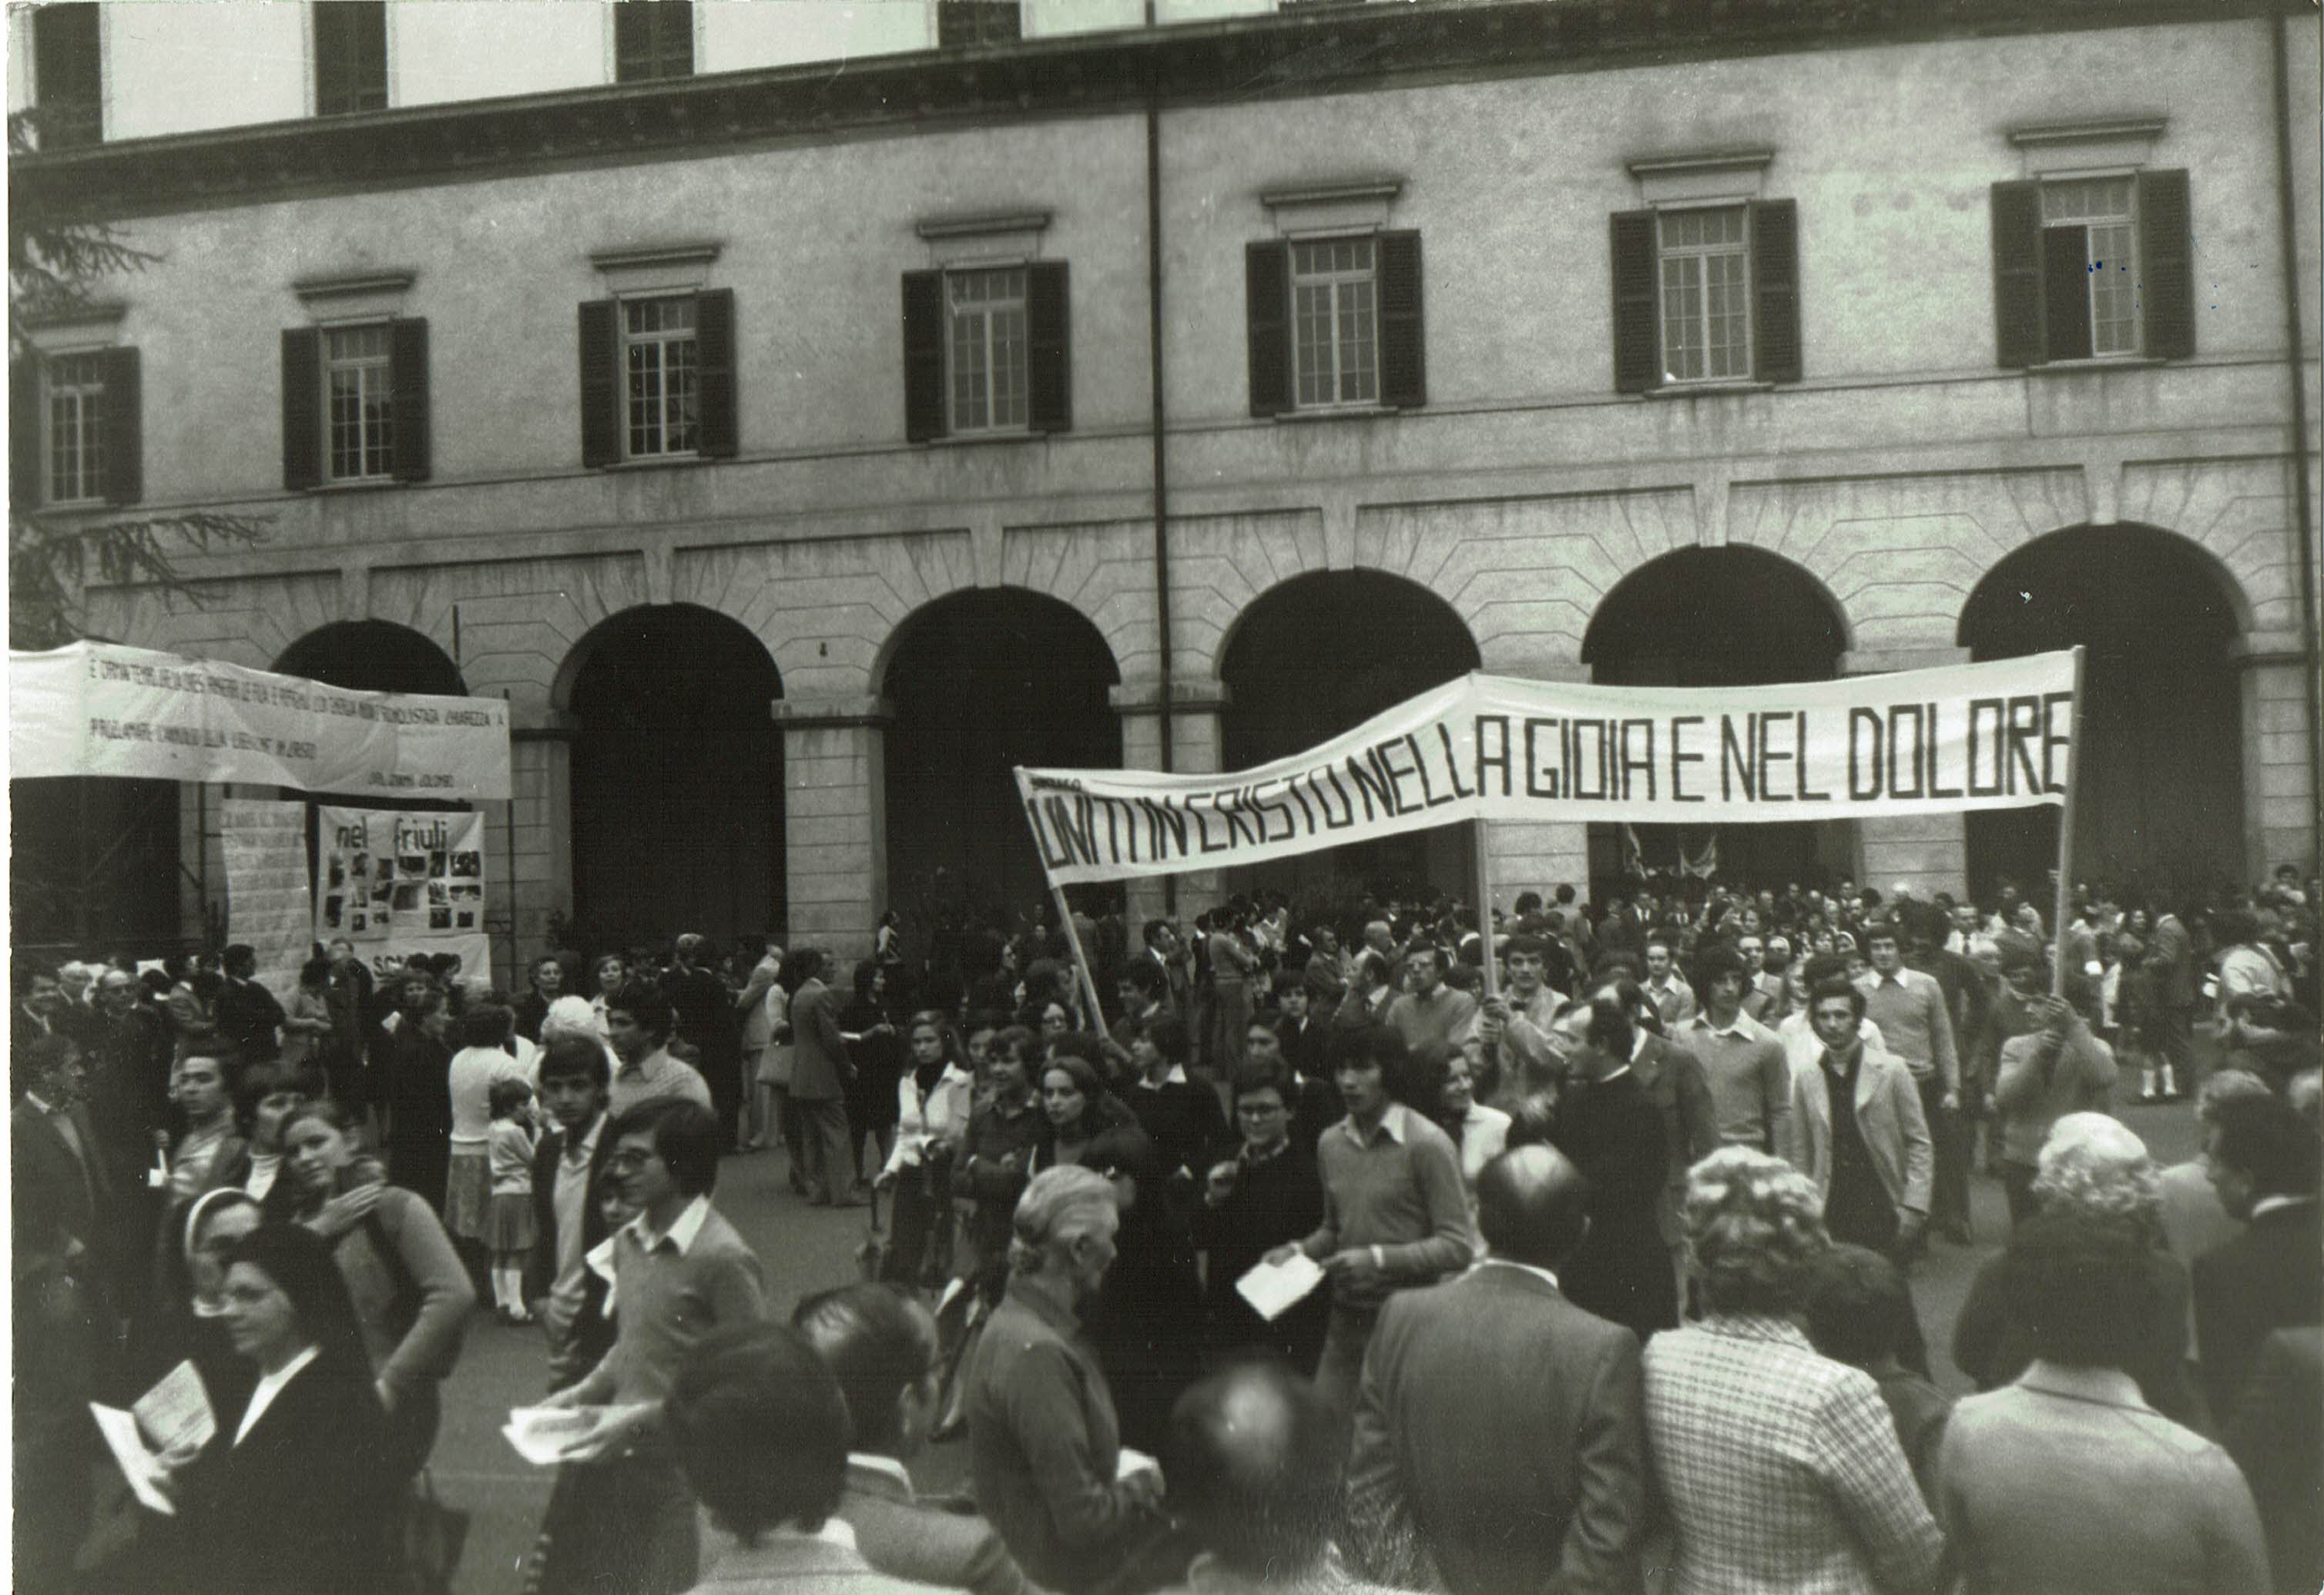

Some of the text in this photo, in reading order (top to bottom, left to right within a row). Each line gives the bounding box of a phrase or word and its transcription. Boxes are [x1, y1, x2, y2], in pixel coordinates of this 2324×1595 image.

[336, 815, 449, 852] nel friuli
[1028, 690, 2074, 870] UNITI IN CRISTO NELLA GIOIA E NEL DOLORE
